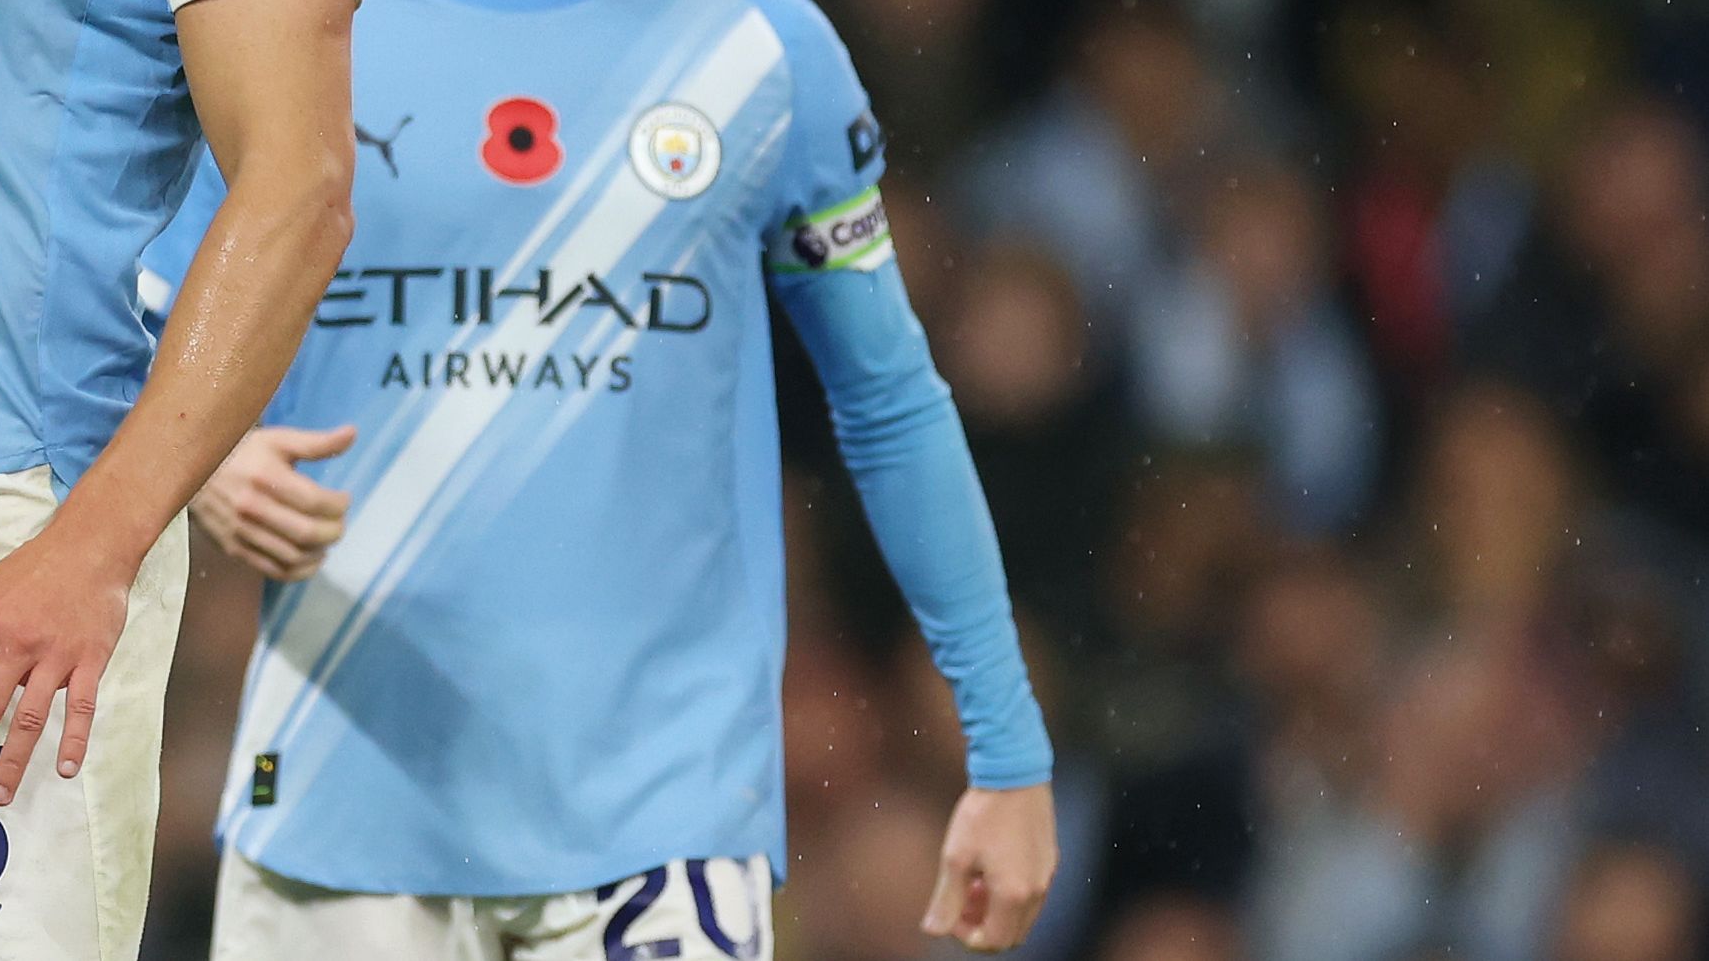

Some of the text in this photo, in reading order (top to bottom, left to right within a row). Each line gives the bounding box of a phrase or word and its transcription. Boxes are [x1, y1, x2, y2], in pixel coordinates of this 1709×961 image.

[314, 266, 713, 335] ETIHAD
[380, 350, 634, 393] AIRWAYS
[596, 858, 761, 961] 20
